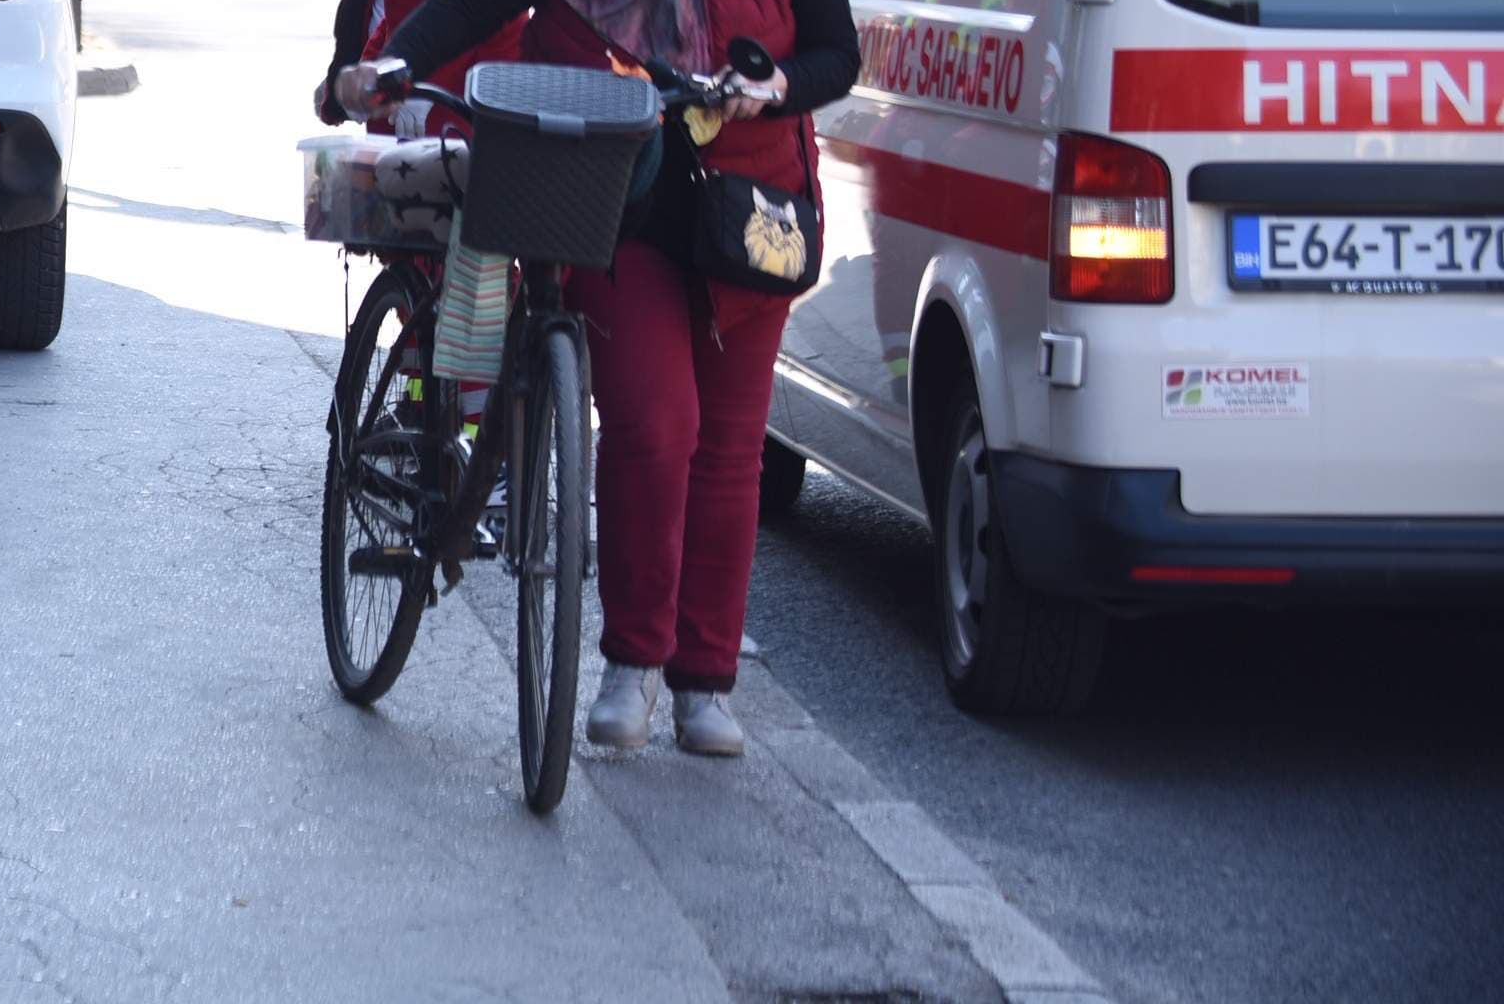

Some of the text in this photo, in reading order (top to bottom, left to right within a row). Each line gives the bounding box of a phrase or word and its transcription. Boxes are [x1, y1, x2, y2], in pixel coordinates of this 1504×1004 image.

[916, 25, 1025, 115] SARAJEVO
[1234, 251, 1260, 269] BIH
[1205, 368, 1307, 384] KOMEL
